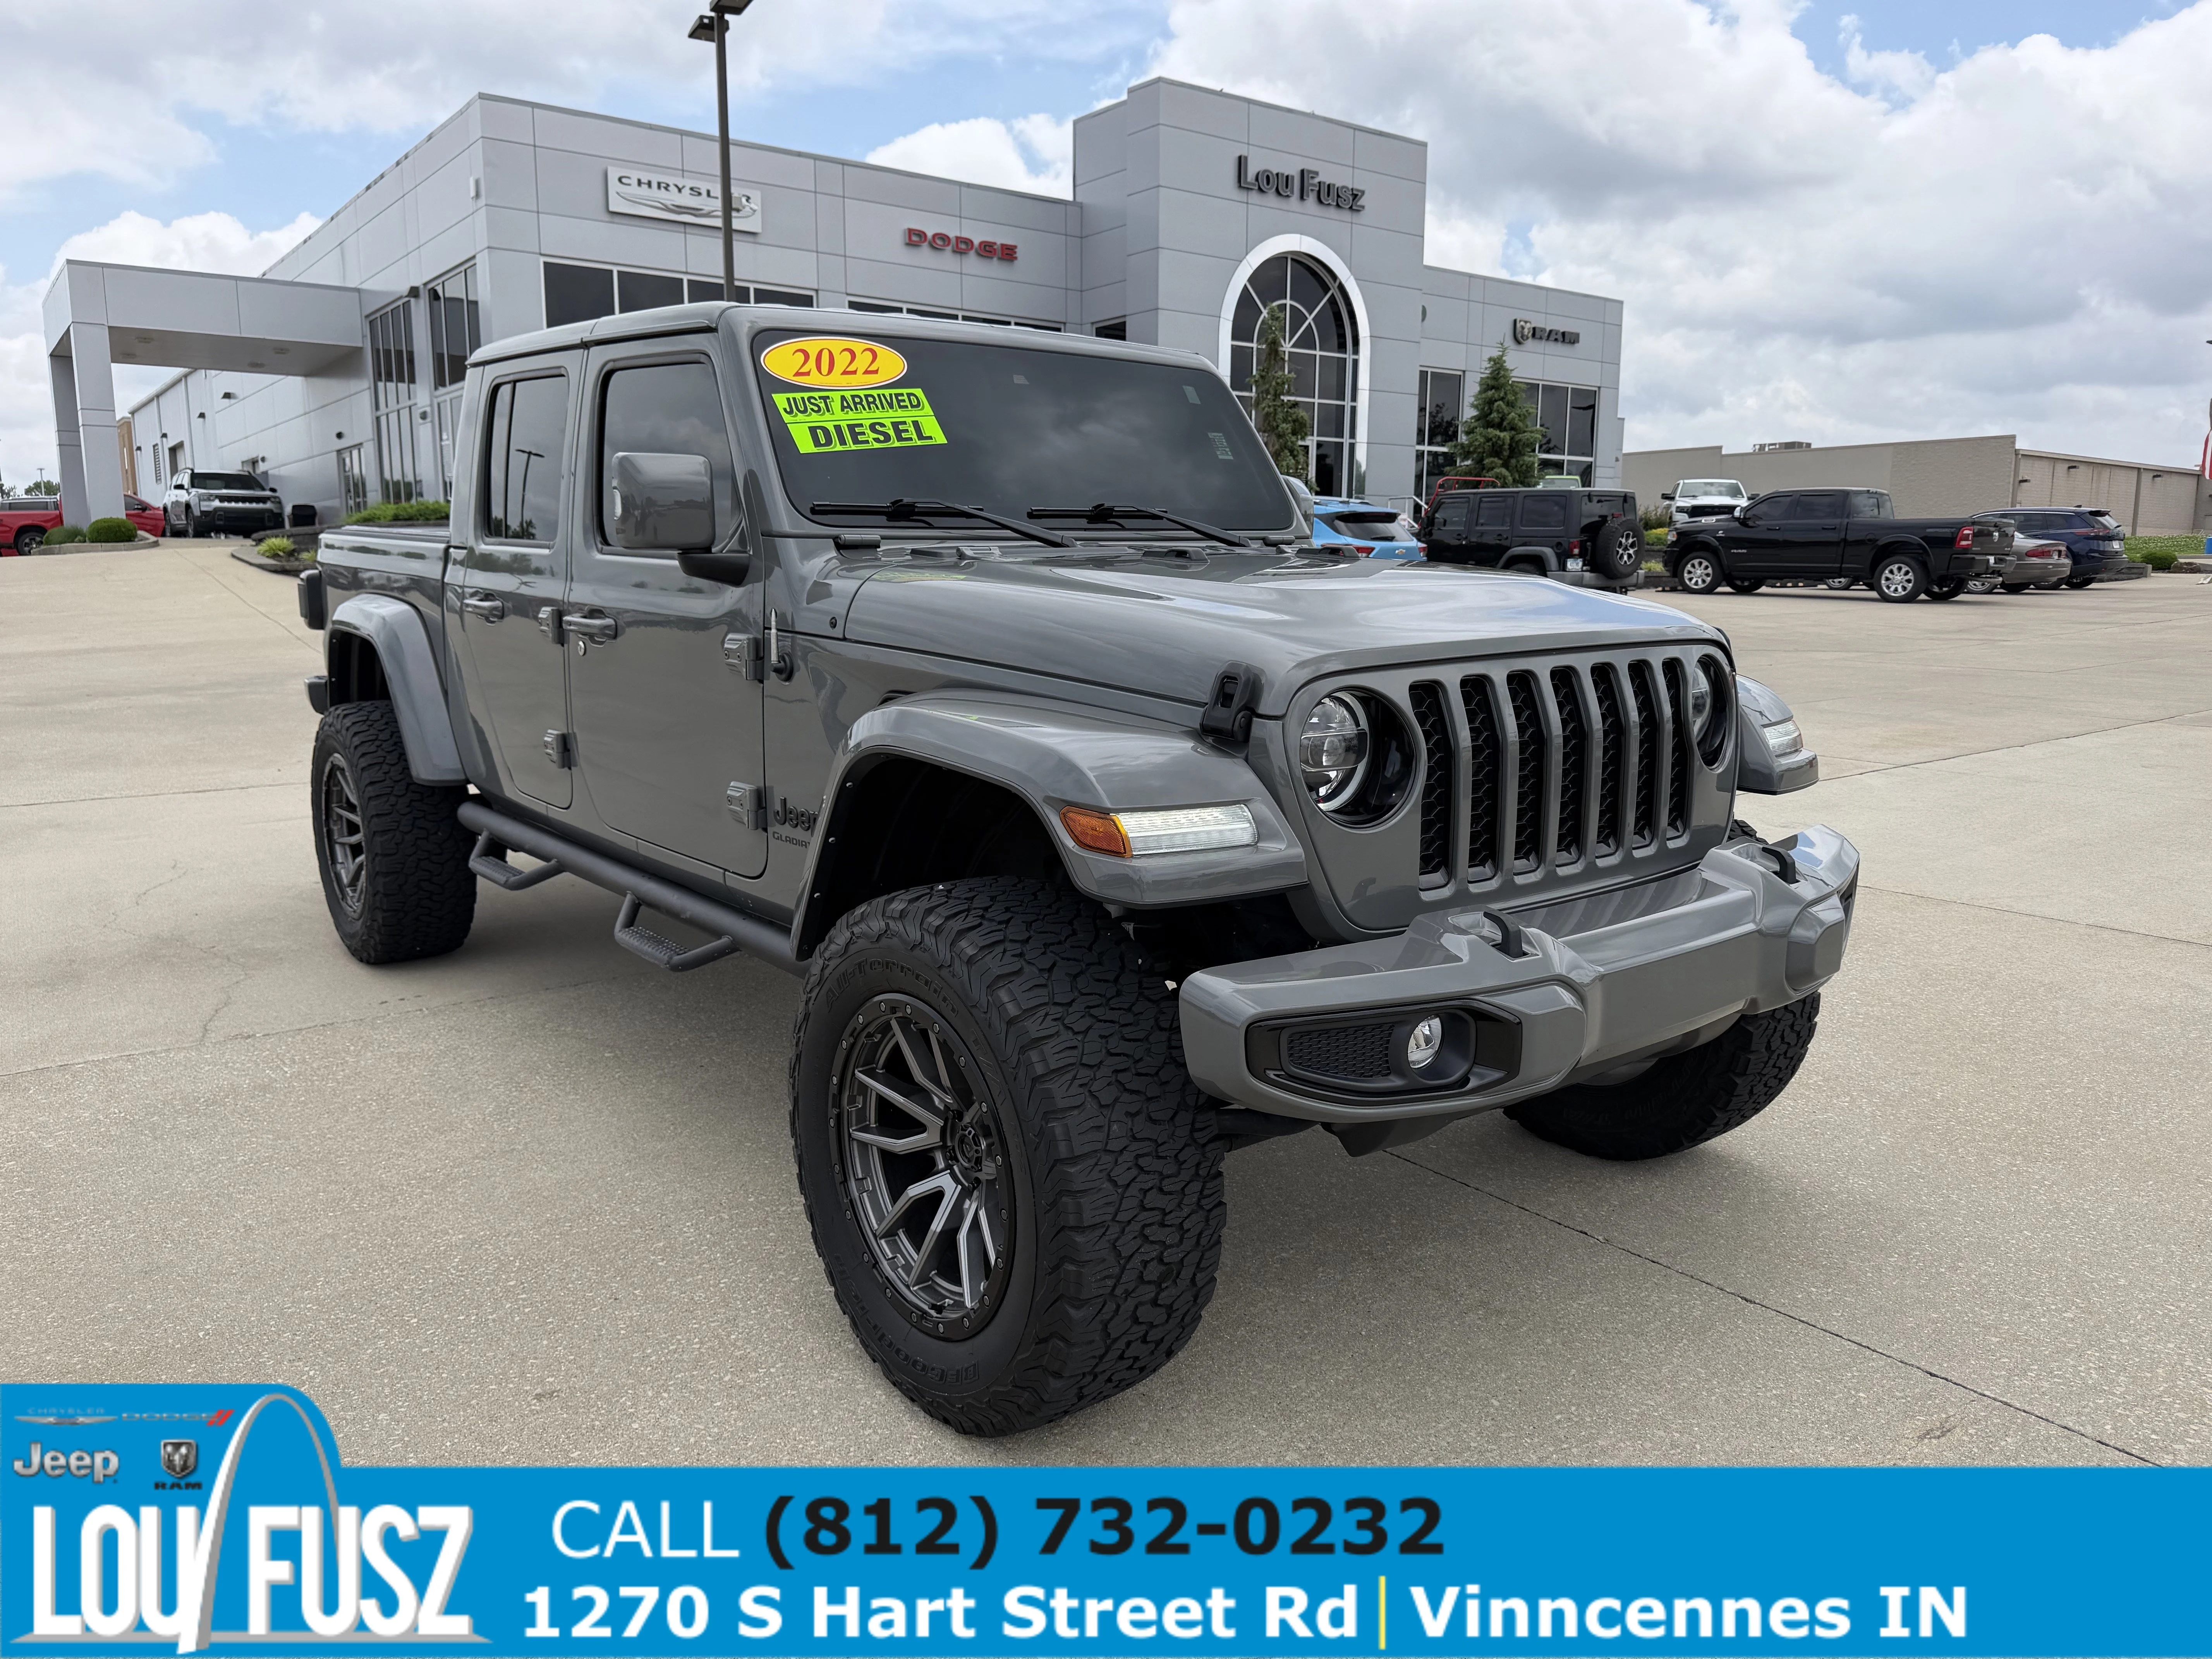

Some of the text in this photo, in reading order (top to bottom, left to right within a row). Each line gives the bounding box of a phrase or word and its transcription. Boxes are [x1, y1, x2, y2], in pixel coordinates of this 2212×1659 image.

[617, 175, 751, 204] CHRYSL
[1237, 155, 1365, 211] Lou Fusz
[905, 227, 1018, 261] DODGE
[1532, 326, 1580, 344] RAM
[792, 347, 880, 377] 2022
[783, 392, 922, 417] JUST ARRIVED
[808, 420, 935, 449] DIESEL
[825, 957, 958, 1017] All-Terrain
